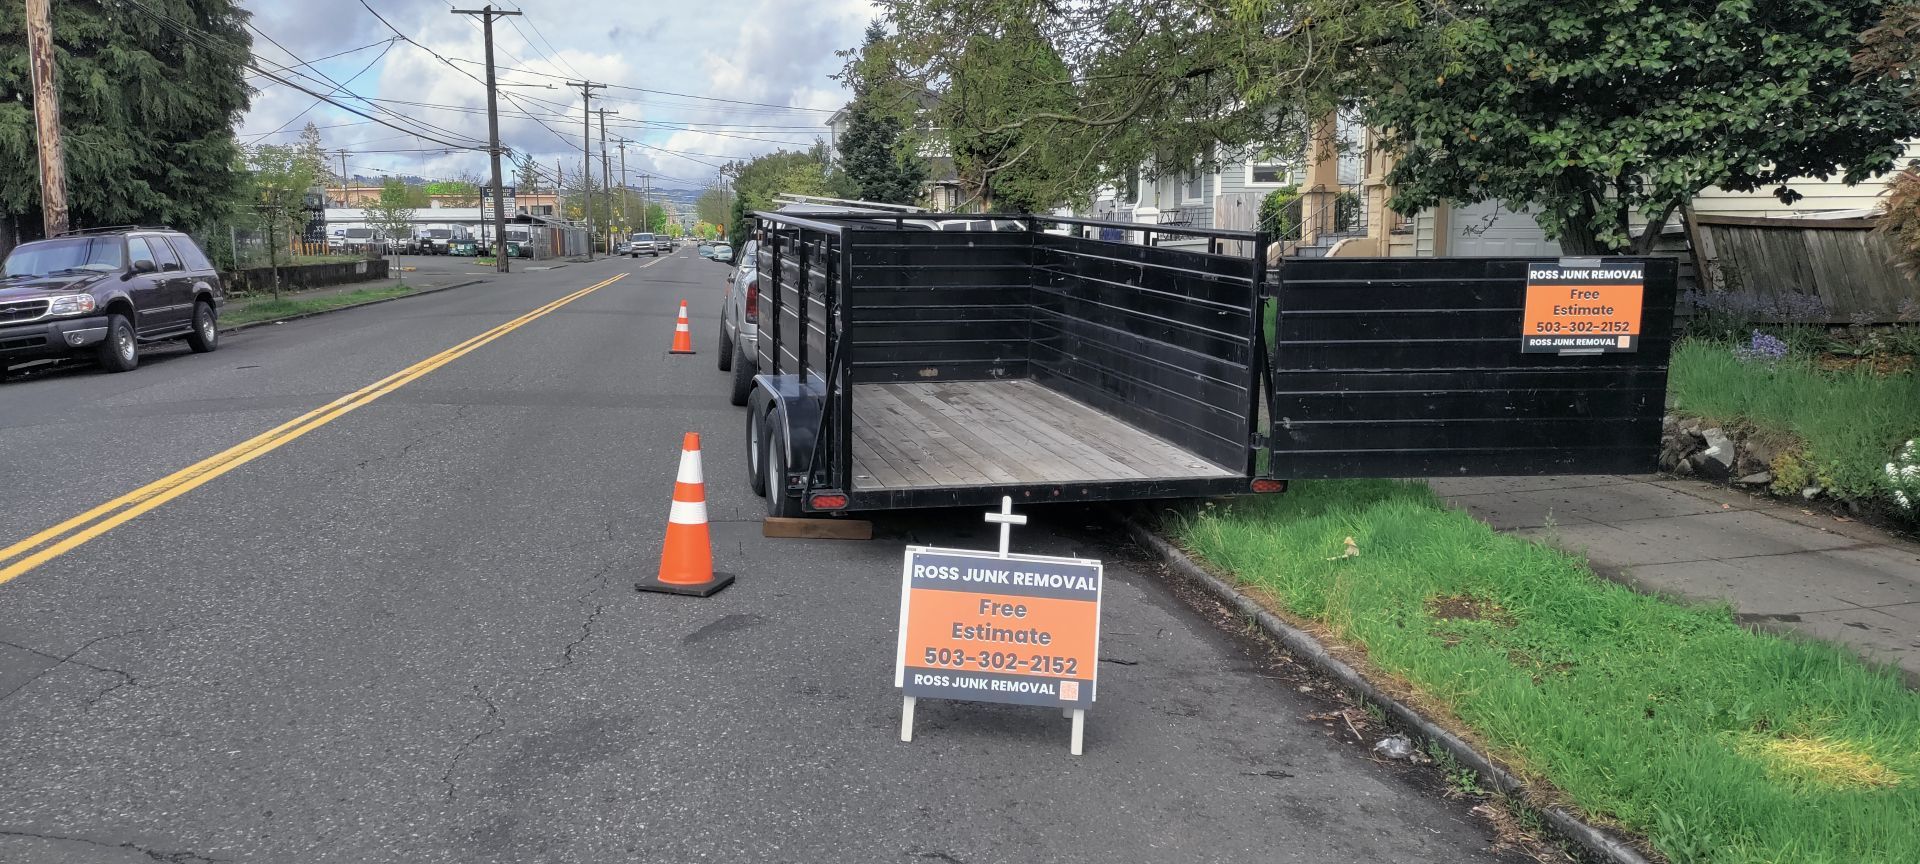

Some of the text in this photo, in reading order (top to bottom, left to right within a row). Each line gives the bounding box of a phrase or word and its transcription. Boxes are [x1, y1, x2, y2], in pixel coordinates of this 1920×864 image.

[1530, 270, 1643, 279] ROSS JUNK REMOVAL
[1570, 289, 1600, 300] Free
[1553, 304, 1614, 316] Estimate
[1536, 321, 1630, 333] 503-302-2152
[1529, 338, 1616, 346] ROSS JUNK REMOVAL
[914, 564, 1097, 591] ROSS JUNK REMOVAL
[979, 598, 1027, 618] Free
[951, 622, 1052, 646] Estimate
[924, 647, 1078, 675] 503-302-2152
[914, 674, 1056, 695] ROSS JUNK REMOVAL
